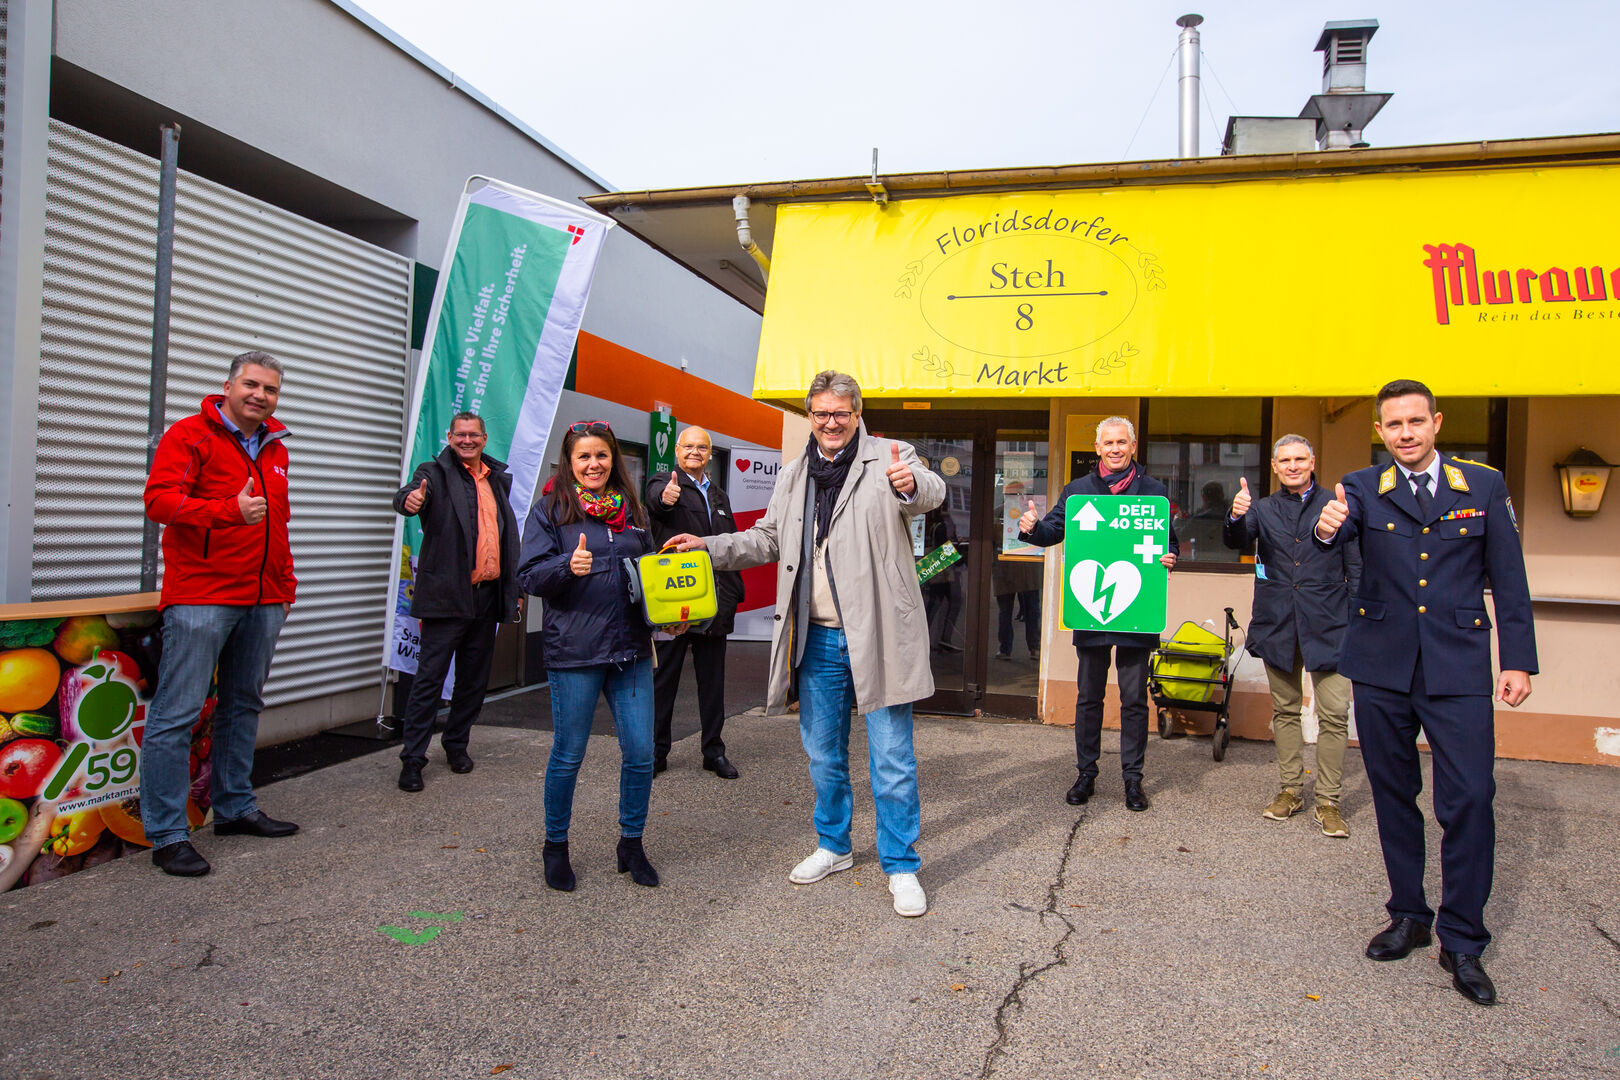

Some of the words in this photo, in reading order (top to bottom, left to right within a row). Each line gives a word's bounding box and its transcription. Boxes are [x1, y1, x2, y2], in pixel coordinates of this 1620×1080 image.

[936, 209, 1129, 255] Floridsdorfer
[492, 243, 528, 325] Sicherheit.
[990, 260, 1066, 290] Steh
[465, 282, 495, 343] Vielfalt.
[1015, 303, 1034, 331] 8
[1478, 311, 1519, 323] Rein
[1530, 310, 1562, 321] das
[482, 327, 502, 359] Ihre
[456, 347, 476, 380] Ihre
[474, 357, 492, 396] sind
[976, 361, 1068, 386] Markt
[656, 462, 669, 473] DEFI
[753, 461, 782, 476] Pul
[1108, 517, 1130, 530] 40
[1133, 518, 1165, 531] SEK
[1119, 504, 1155, 517] DEFI
[665, 575, 697, 590] AED
[401, 628, 421, 646] Sta
[397, 642, 421, 661] Wie
[85, 748, 137, 791] 59
[58, 786, 141, 813] www.marktamt.w
